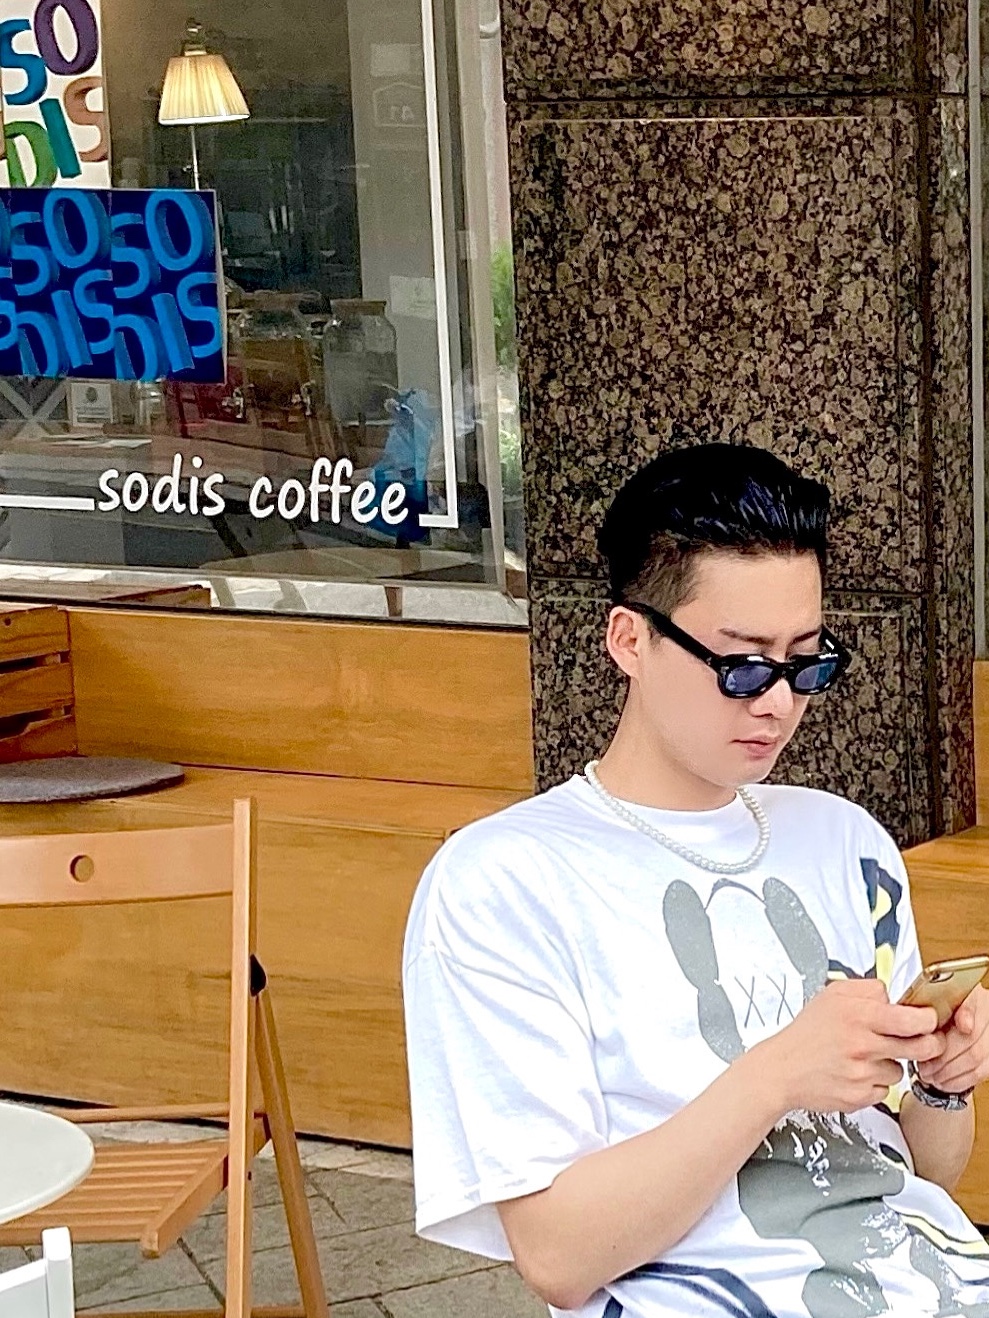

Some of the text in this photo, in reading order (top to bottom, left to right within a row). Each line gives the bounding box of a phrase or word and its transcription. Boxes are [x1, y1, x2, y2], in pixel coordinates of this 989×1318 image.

[0, 0, 98, 106] SO
[98, 453, 409, 524] sodis coffee
